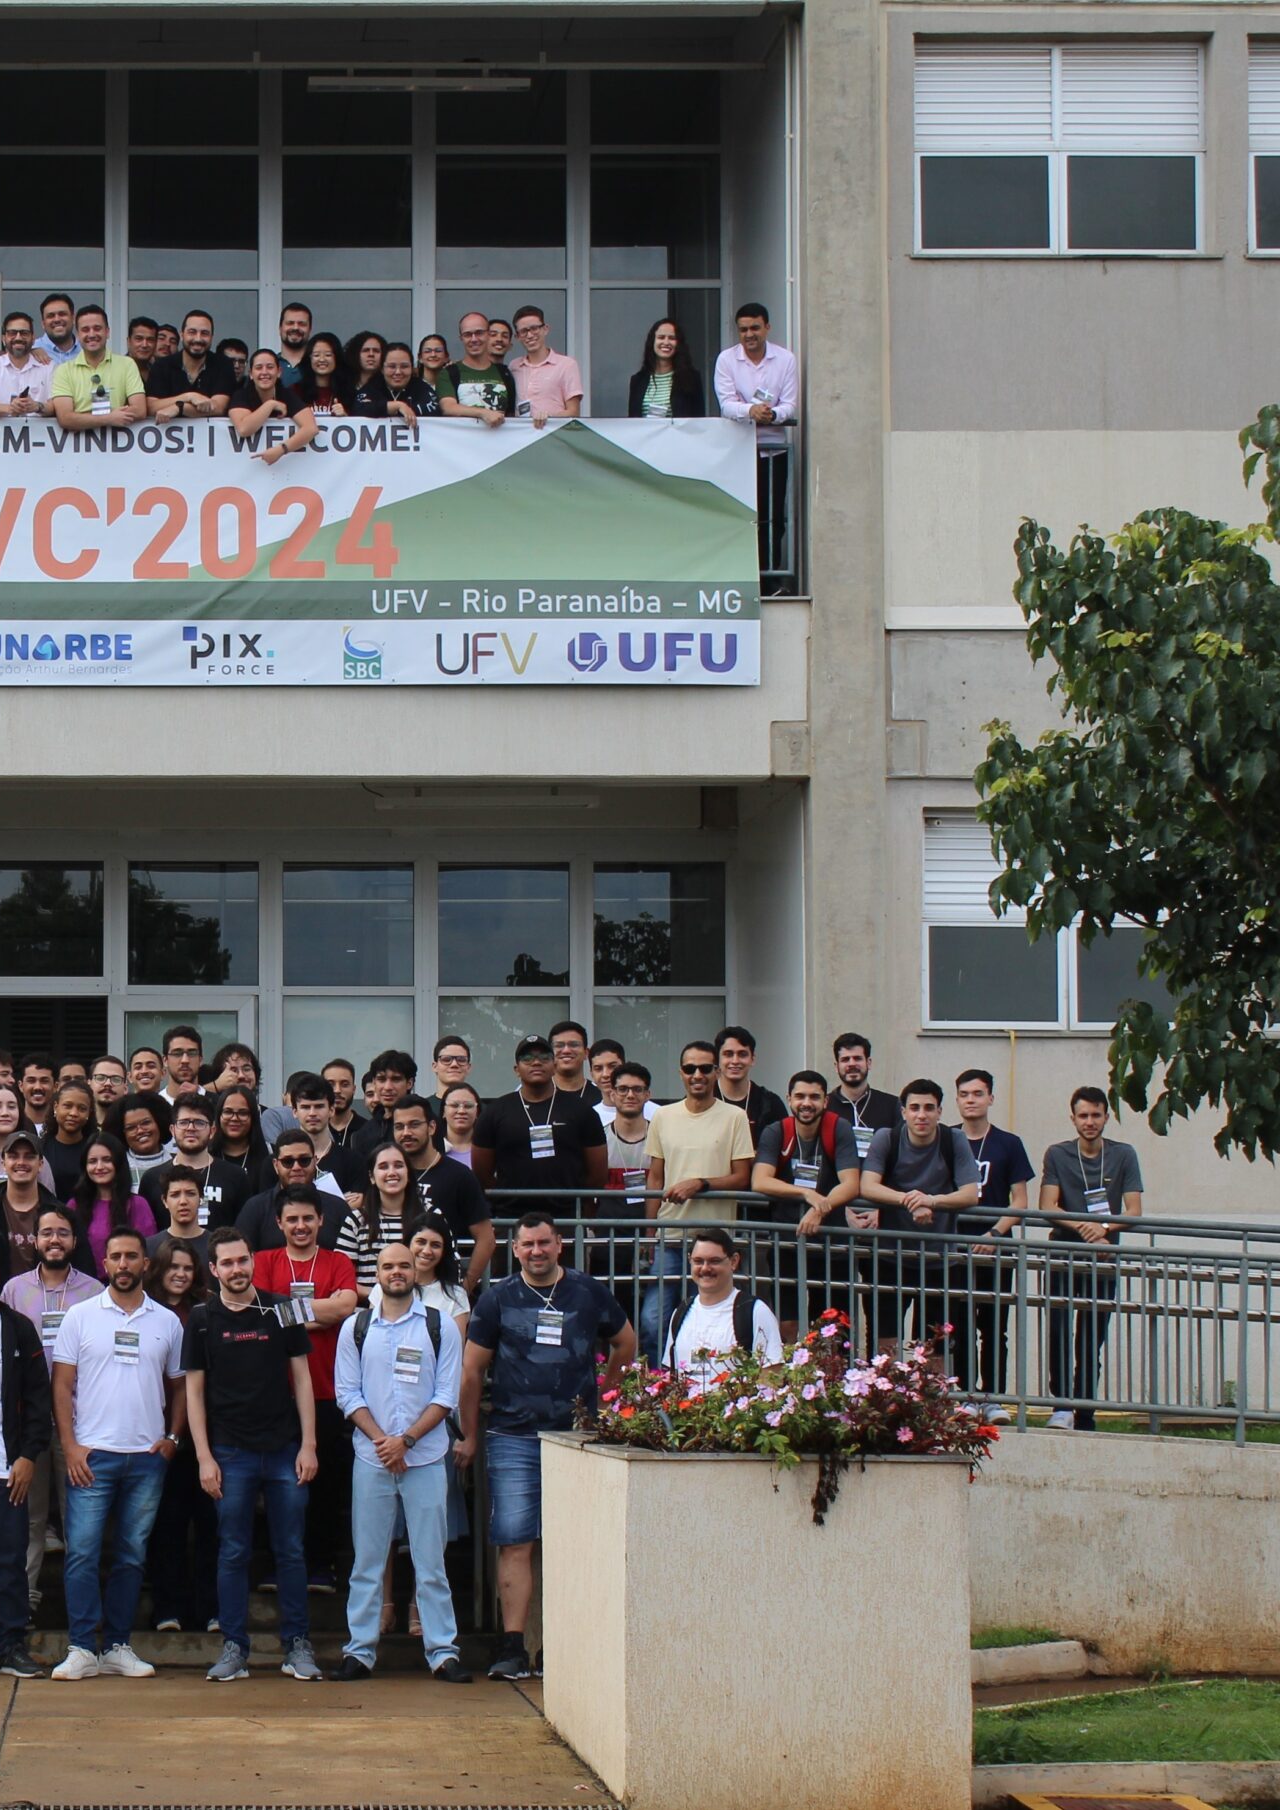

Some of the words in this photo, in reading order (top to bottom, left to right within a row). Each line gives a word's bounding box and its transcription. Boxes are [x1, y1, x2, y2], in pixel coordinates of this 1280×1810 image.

[371, 589, 428, 614] UFV
[462, 589, 508, 613] Rio
[518, 586, 662, 614] Paranaíba
[699, 590, 742, 614] MG
[436, 632, 538, 676] UFV
[619, 632, 738, 673] UFU
[25, 664, 64, 676] Arthur
[68, 664, 133, 676] Bernardes
[208, 665, 275, 675] FORCE
[344, 662, 380, 679] SBC
